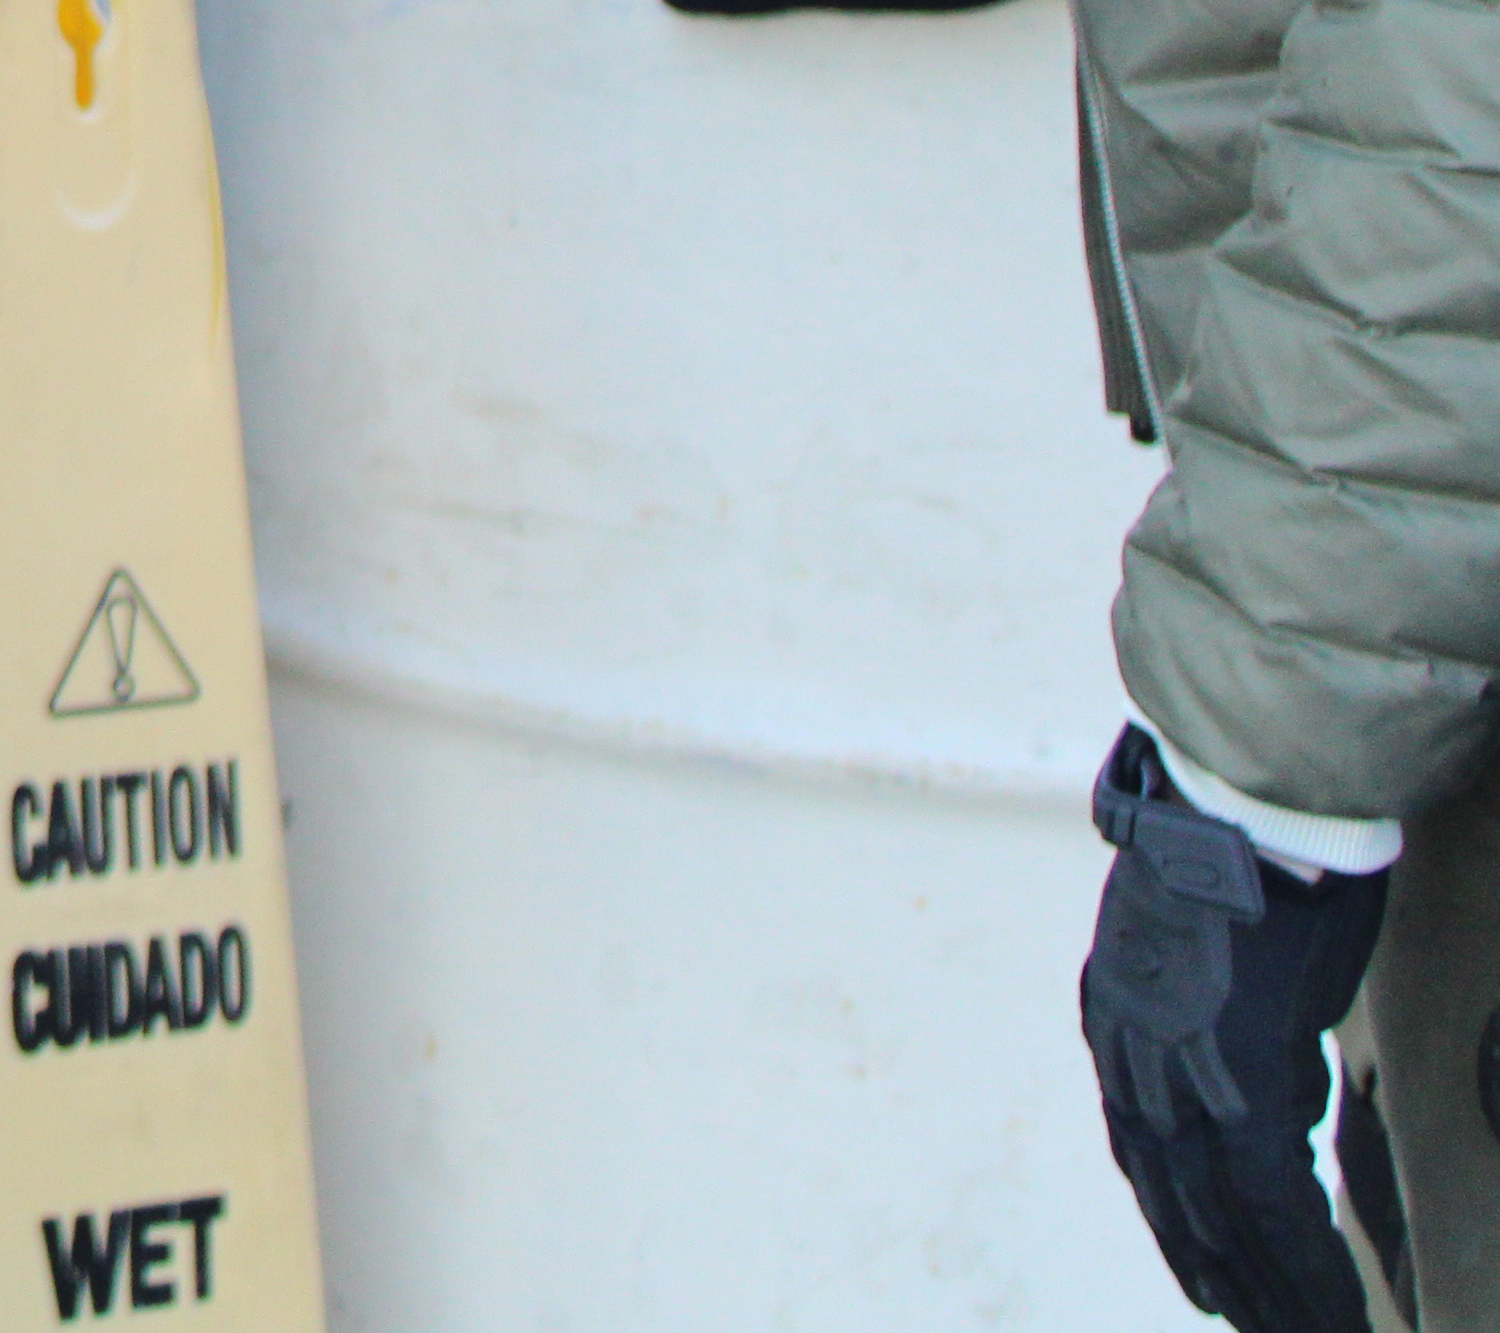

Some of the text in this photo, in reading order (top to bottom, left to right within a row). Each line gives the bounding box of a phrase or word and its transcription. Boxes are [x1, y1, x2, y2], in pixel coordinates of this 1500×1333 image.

[10, 758, 242, 888] CAUTION
[10, 925, 252, 1053] CUIDADO
[40, 1193, 226, 1321] WET
